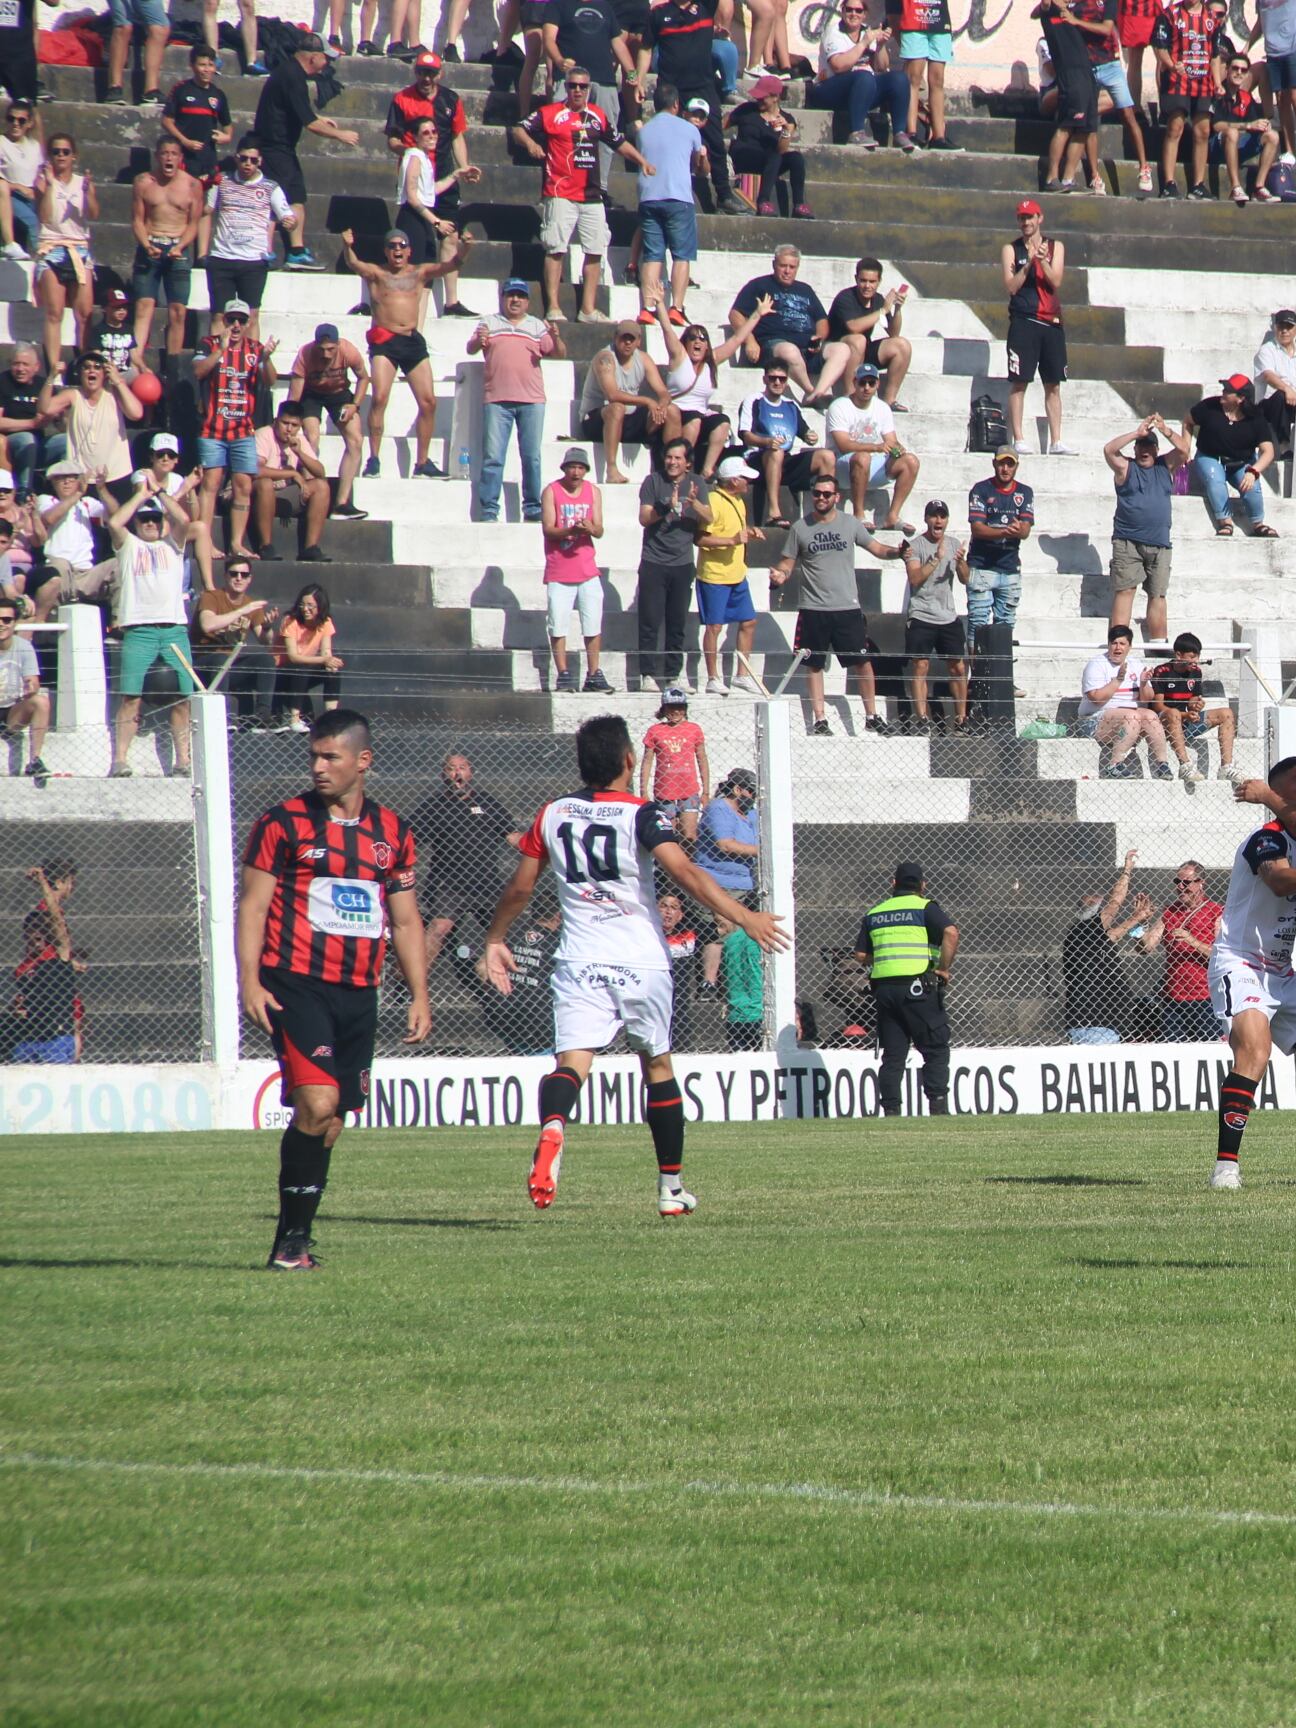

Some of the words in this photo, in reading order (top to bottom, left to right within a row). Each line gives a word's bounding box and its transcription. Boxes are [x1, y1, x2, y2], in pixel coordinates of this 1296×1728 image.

[813, 531, 841, 543] Take
[807, 540, 848, 555] Courage
[596, 806, 625, 817] DESIGN
[556, 822, 621, 884] 10
[337, 892, 367, 908] CH
[871, 911, 914, 926] POLICIA
[589, 973, 625, 987] PABLO
[351, 1076, 524, 1129] INDICATO
[717, 1070, 736, 1122] Y
[1040, 1059, 1141, 1114] BAHIA
[1149, 1053, 1281, 1113] BLANA
